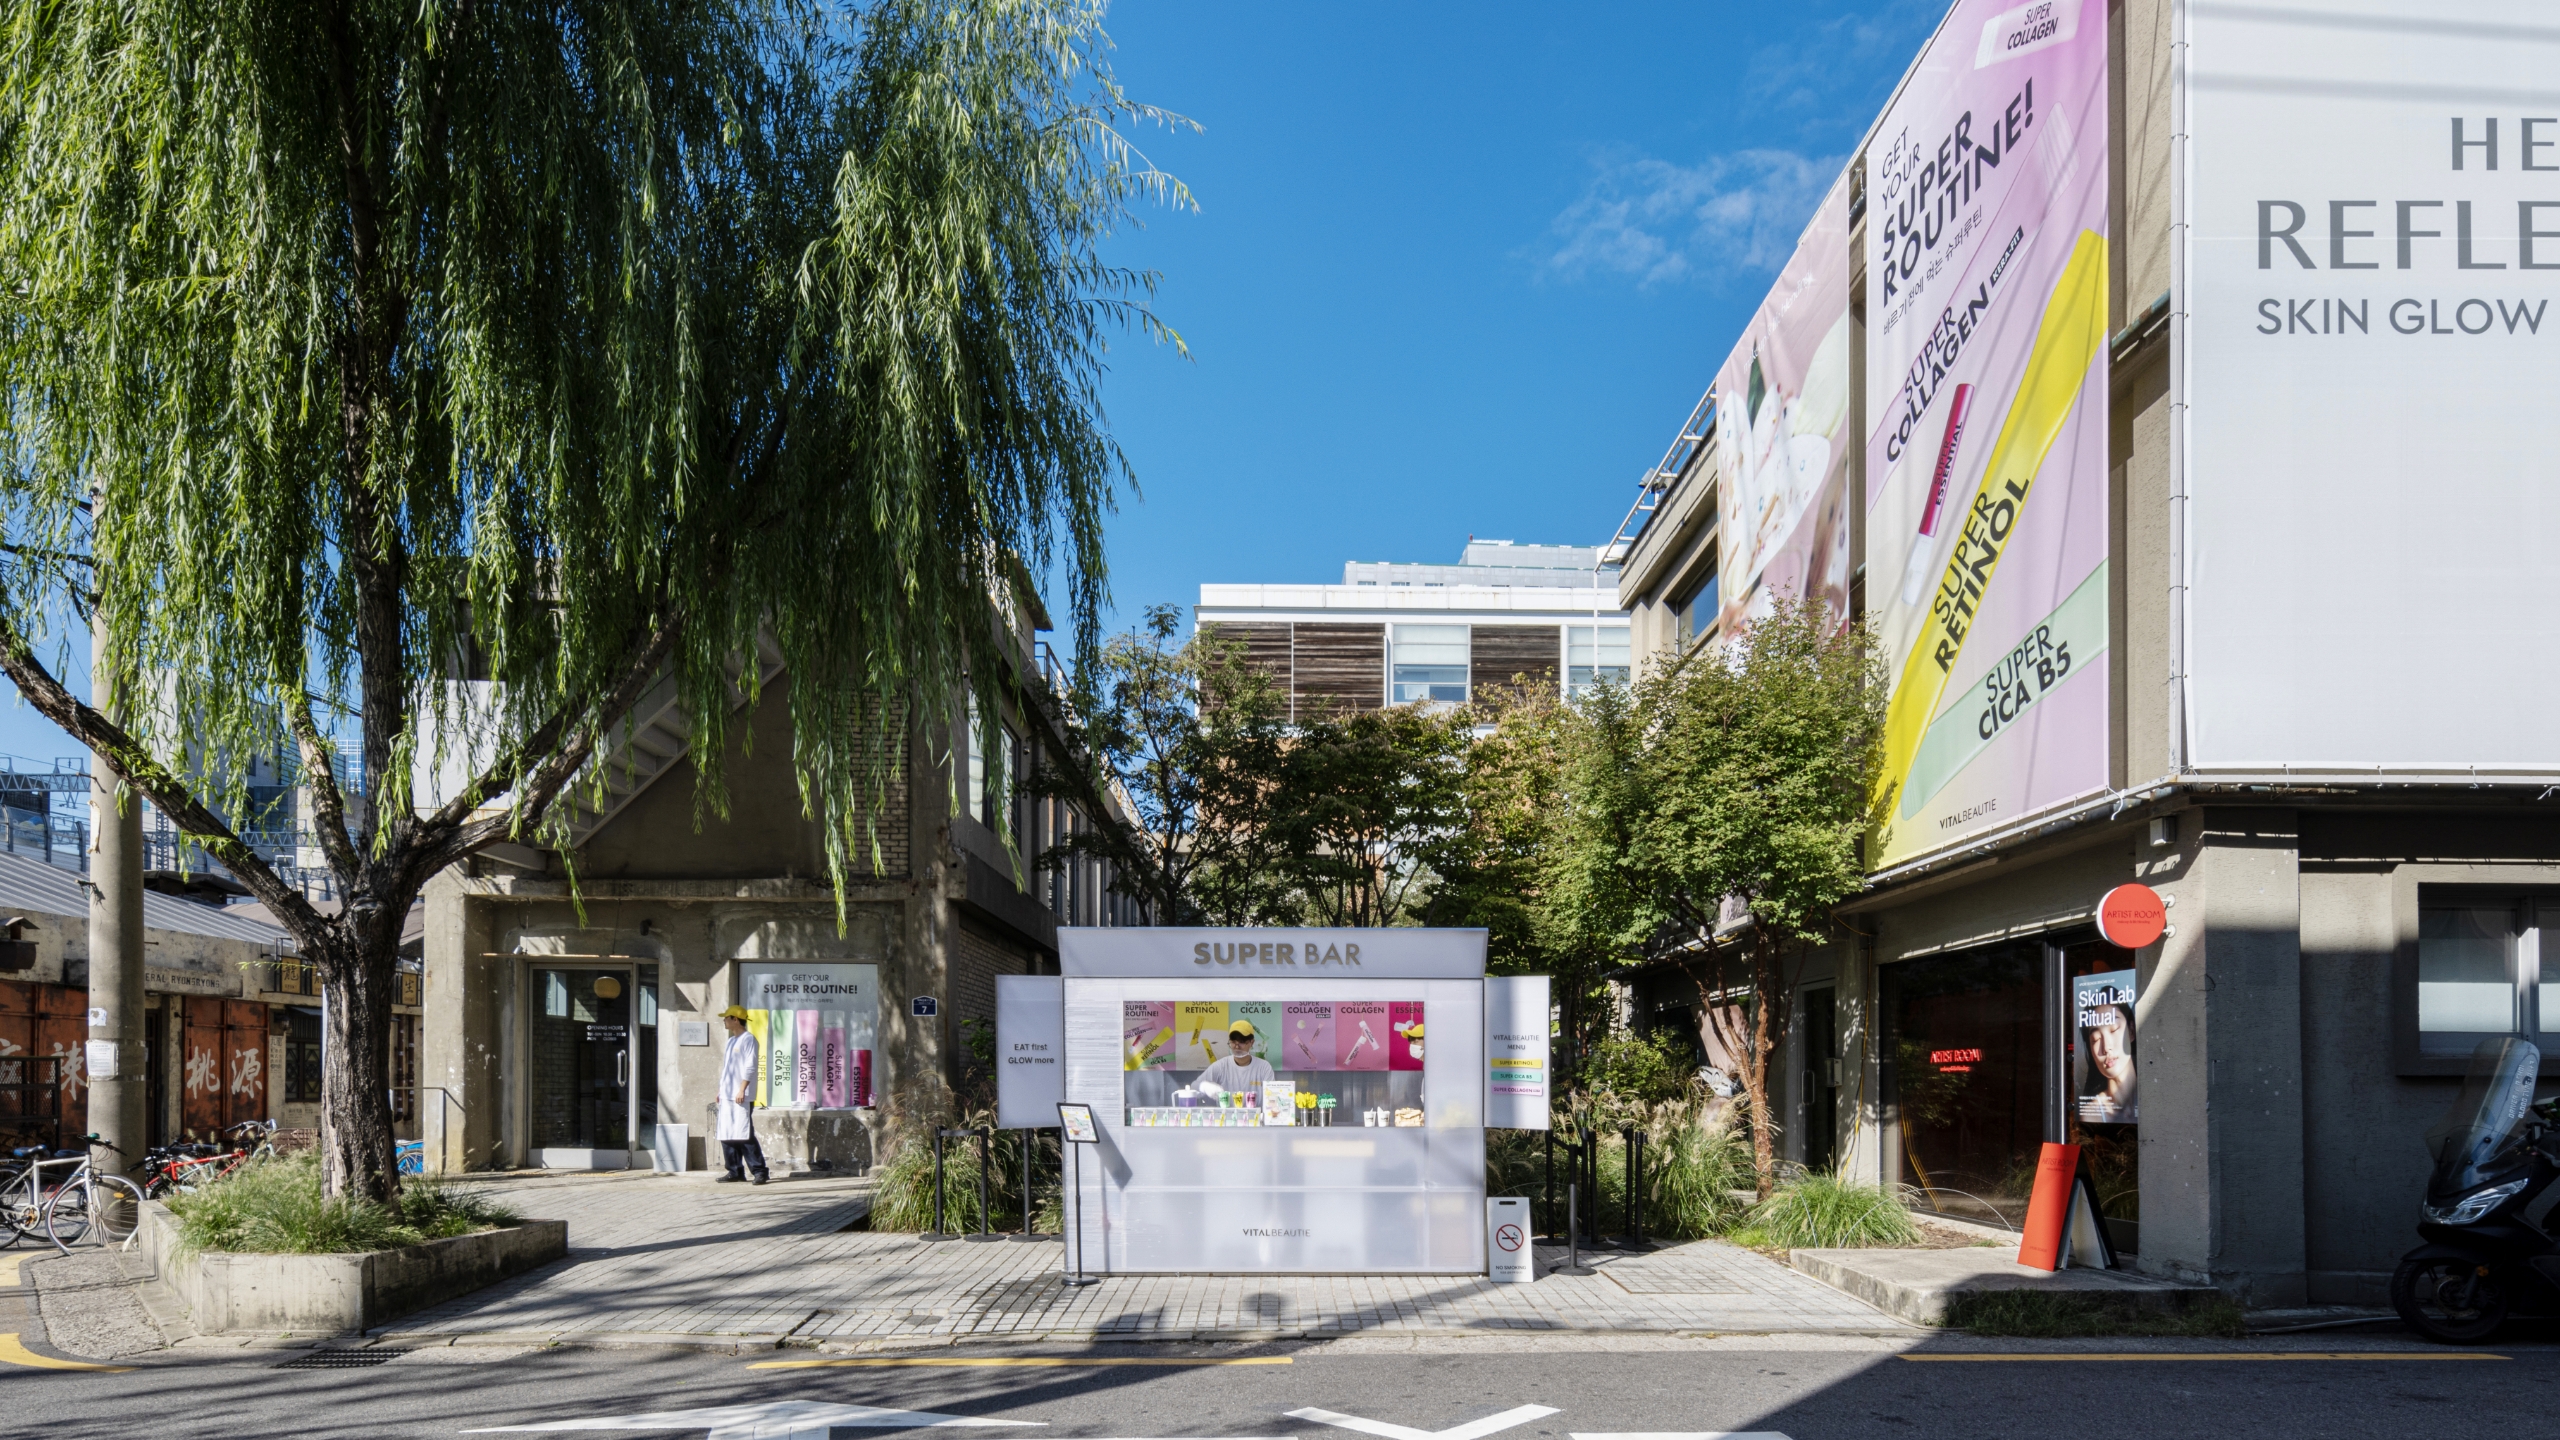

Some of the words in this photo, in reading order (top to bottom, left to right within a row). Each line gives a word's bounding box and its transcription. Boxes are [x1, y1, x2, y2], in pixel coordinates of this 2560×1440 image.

[2024, 1, 2052, 26] SUPER
[2007, 16, 2059, 51] COLLAGEN
[1882, 125, 1909, 180] GET
[2451, 117, 2560, 171] HE
[1882, 142, 1921, 211] YOUR
[1883, 110, 1974, 262] SUPER
[1883, 76, 2034, 309] ROUTINE!
[2257, 200, 2560, 270] REFLE
[1883, 298, 1907, 336] 바르기
[1908, 275, 1924, 308] 전에
[1926, 253, 1943, 282] 먹는
[1945, 204, 1982, 262] 슈퍼루틴
[2257, 298, 2369, 335] SKIN
[2389, 298, 2548, 335] GLOW
[1886, 281, 1990, 463] COLLAGEN
[1991, 229, 2023, 283] KERA-FIT
[1905, 305, 1957, 404] SUPER
[1934, 440, 1951, 485] SUPER
[1935, 420, 1963, 506] ESSENTIAL
[1934, 491, 1997, 624] SUPER
[1934, 477, 2030, 675] RETINOL
[1986, 624, 2054, 704] SUPER
[1978, 684, 2031, 741] CICA
[2038, 641, 2072, 694] B5
[1939, 798, 1997, 830] VITALBEAUTIE
[2106, 910, 2132, 919] ARTIST
[2134, 910, 2161, 919] ROOM
[1193, 942, 1295, 965] SUPER
[1304, 942, 1361, 965] BAR
[145, 972, 166, 983] ERAL
[763, 984, 800, 994] SUPER
[803, 984, 858, 994] ROUTINE!
[791, 974, 806, 982] GET
[808, 974, 830, 982] YOUR
[921, 1005, 928, 1014] 7
[2078, 988, 2107, 1008] Skin
[2109, 984, 2135, 1006] Lab
[1185, 1006, 1220, 1014] RETINOL
[1240, 1006, 1260, 1014] CICA
[1261, 1006, 1272, 1014] B5
[1287, 1006, 1331, 1014] COLLAGEN
[1340, 1006, 1385, 1014] COLLAGEN
[2078, 1008, 2116, 1028] Ritual
[774, 1049, 783, 1072] CICA
[1008, 1056, 1033, 1064] GLOW
[1014, 1043, 1030, 1051] EAT
[1031, 1043, 1048, 1051] first
[1930, 1050, 1953, 1063] ARTIST
[1954, 1048, 1980, 1063] ROOM
[758, 1055, 766, 1082] SUPER
[774, 1074, 783, 1087] B5
[783, 1055, 791, 1082] SUPER
[799, 1043, 809, 1093] COLLAGEN
[808, 1055, 817, 1081] SUPER
[826, 1043, 835, 1092] COLLAGEN
[835, 1055, 843, 1080] SUPER
[1242, 1228, 1311, 1237] VITALBEAUTIE
